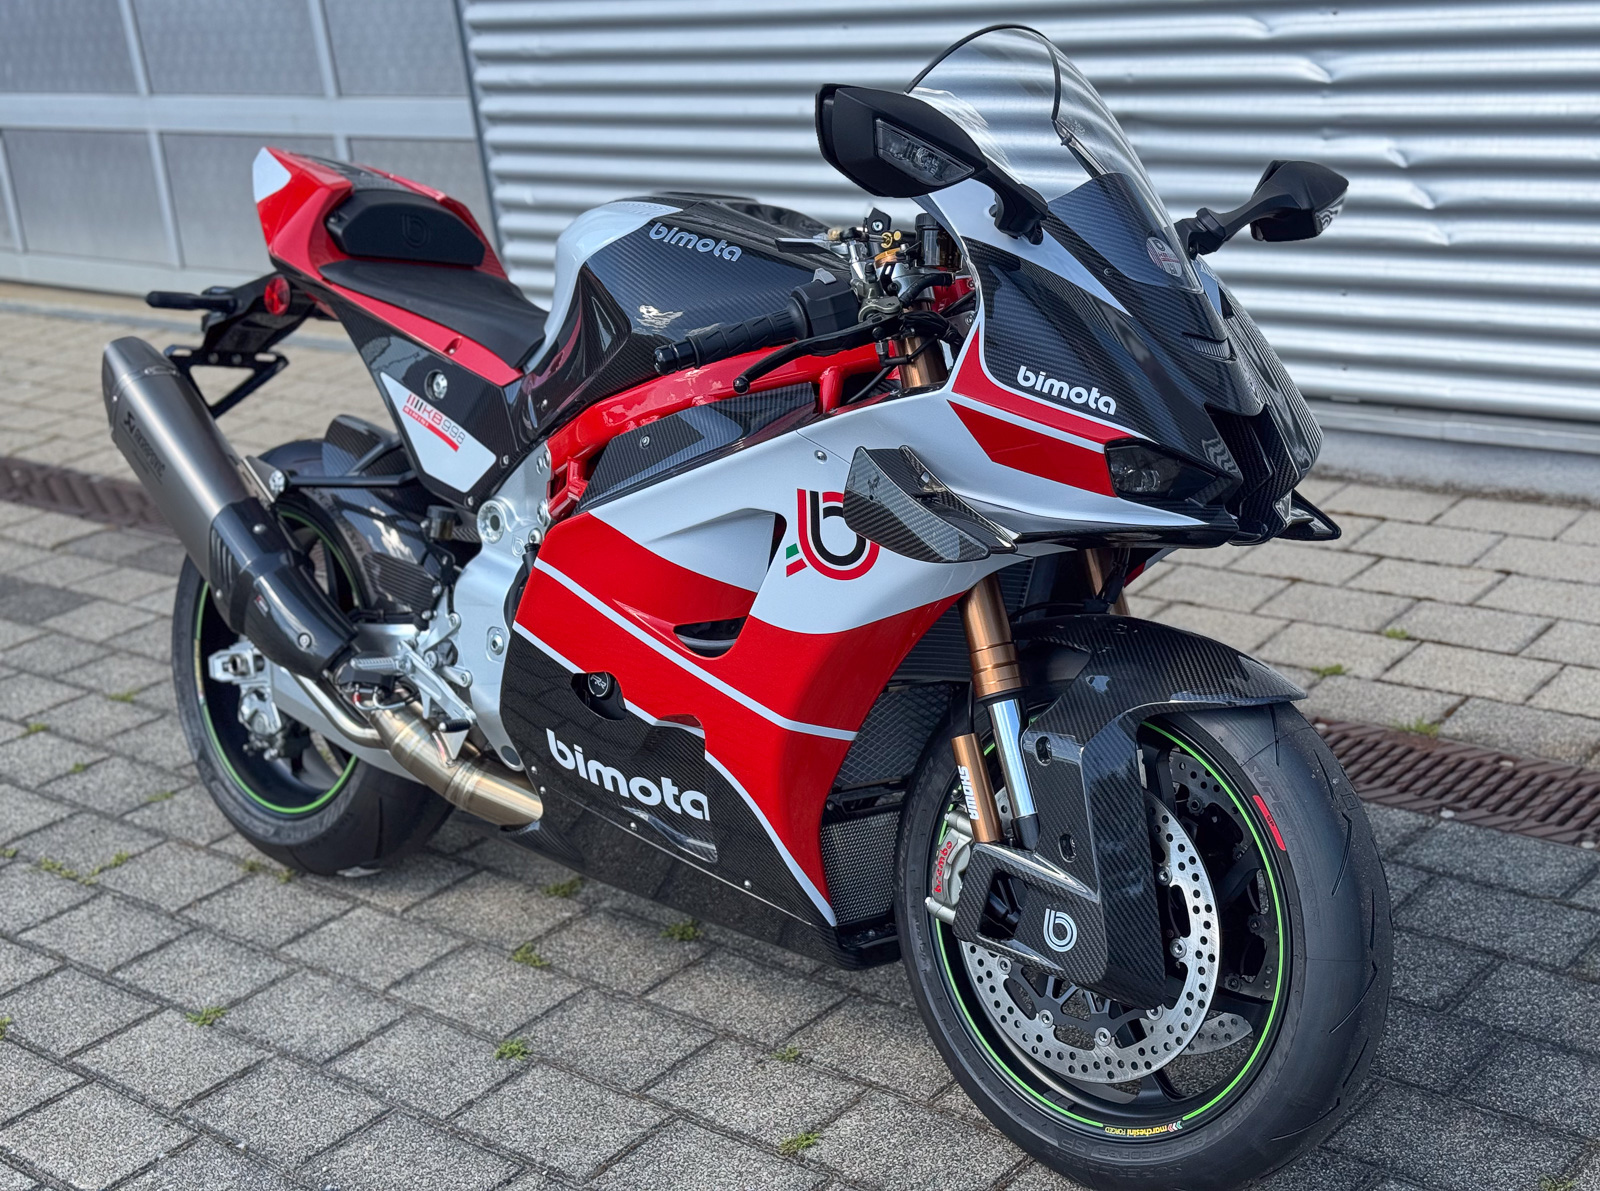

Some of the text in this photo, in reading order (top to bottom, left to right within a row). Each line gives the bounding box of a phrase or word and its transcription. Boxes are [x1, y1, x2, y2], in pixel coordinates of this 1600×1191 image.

[649, 222, 742, 262] bimota
[1017, 365, 1116, 415] bimota
[546, 728, 710, 821] bimota
[958, 765, 980, 820] SHOWA
[936, 841, 953, 893] brembo
[1105, 1125, 1167, 1137] marchesini FORGED
